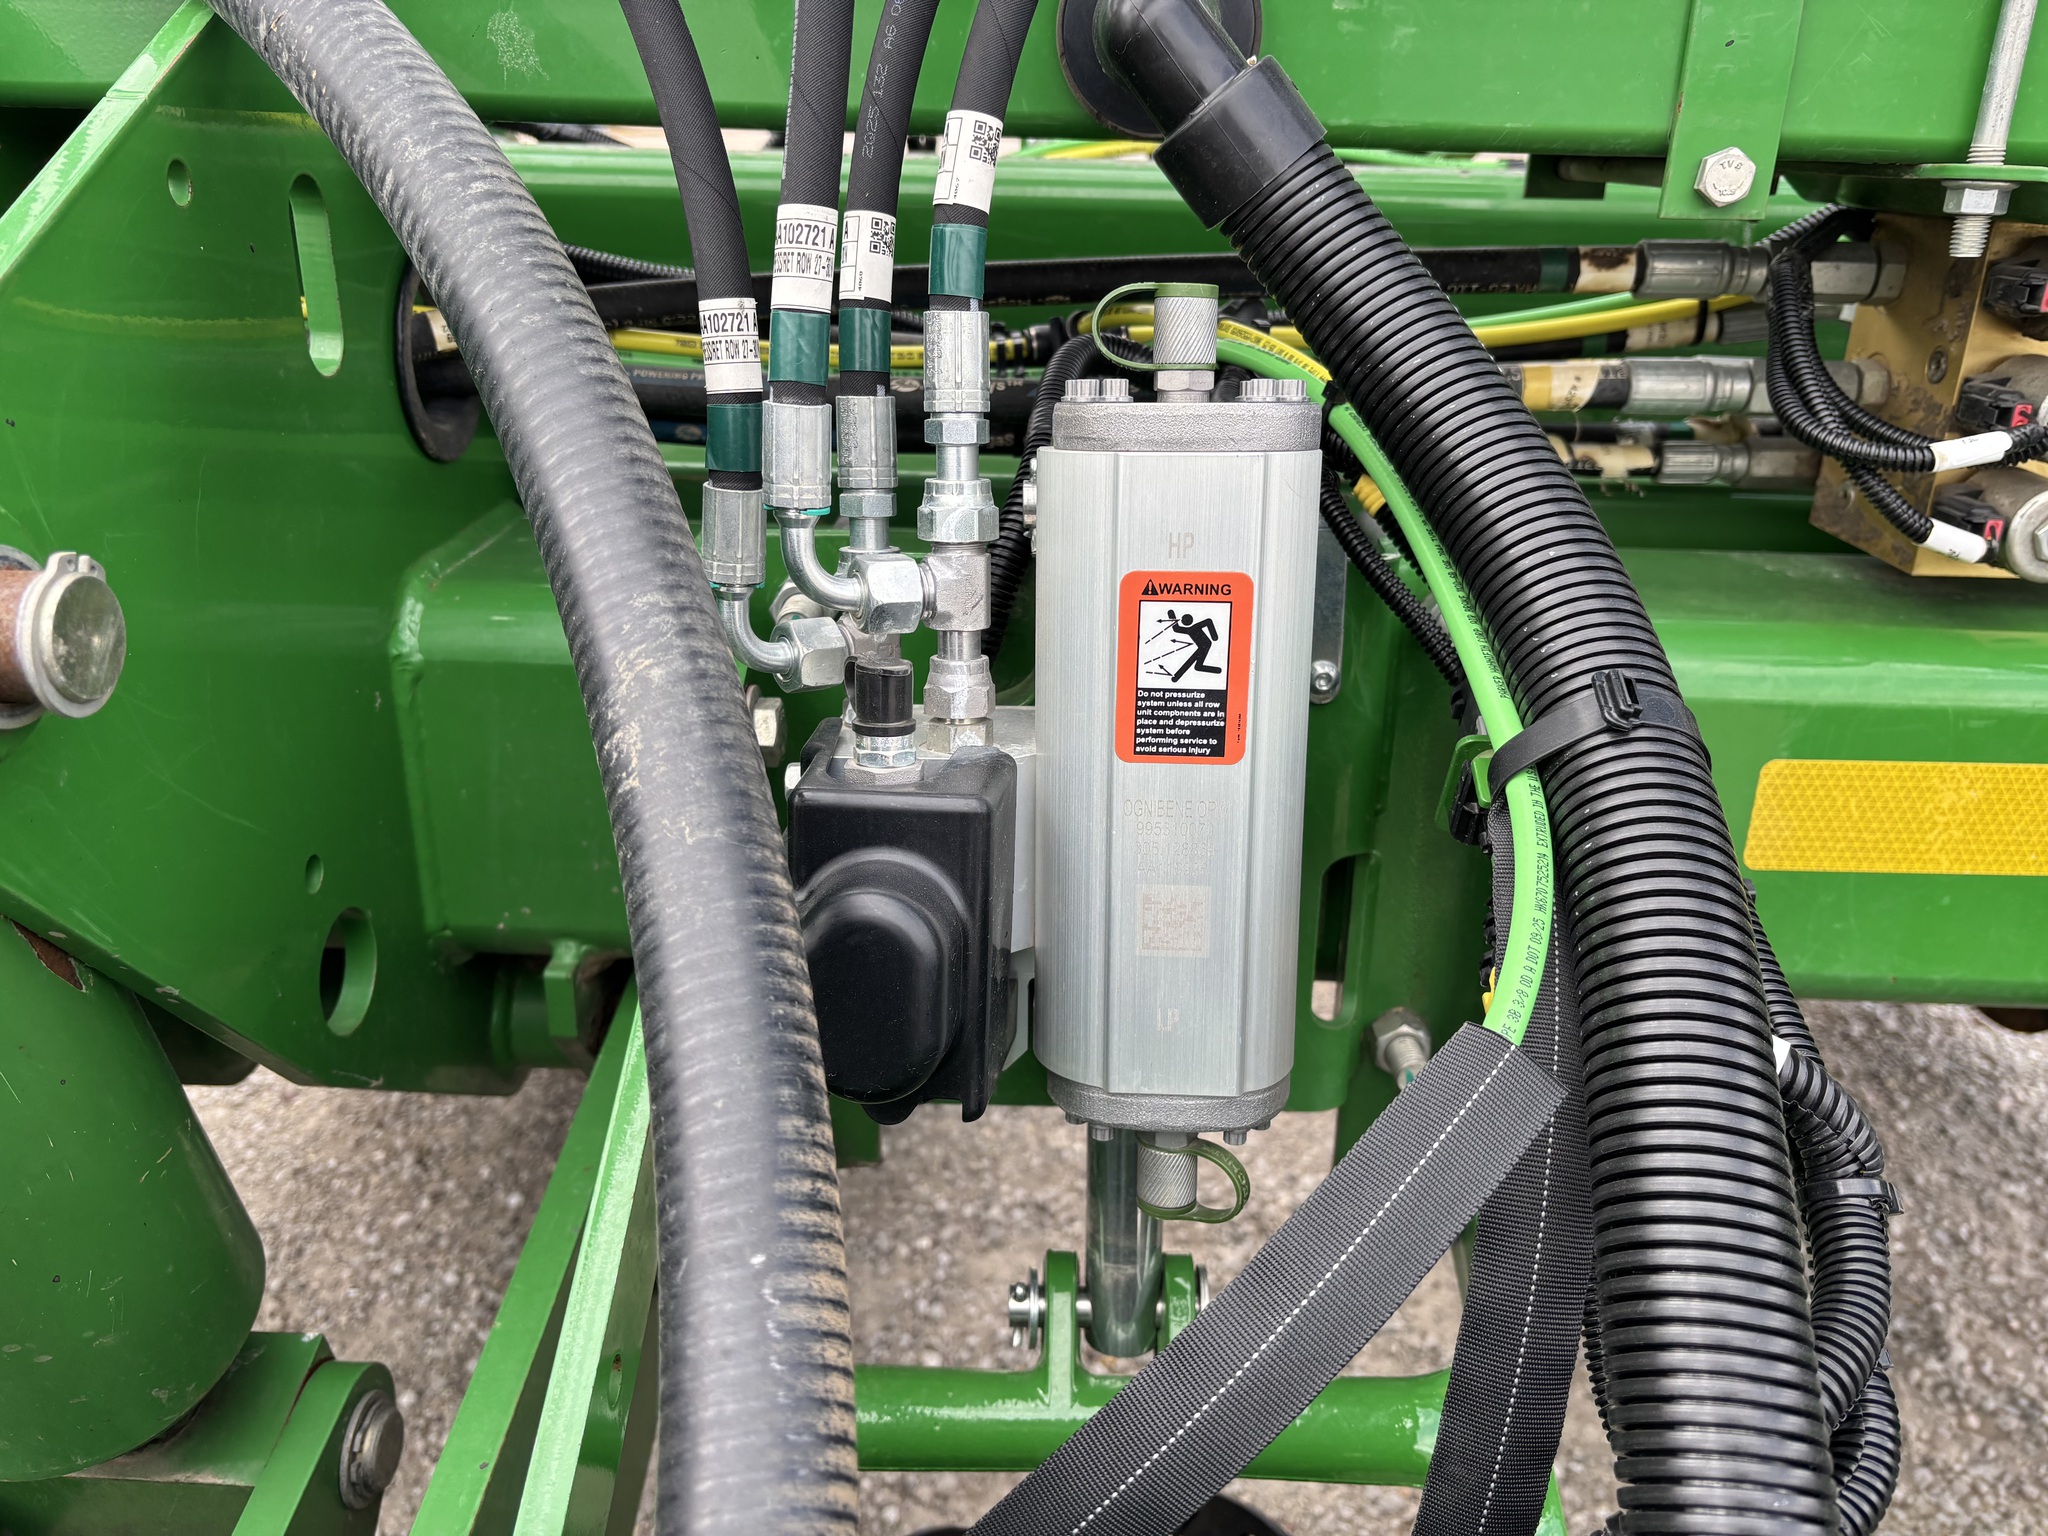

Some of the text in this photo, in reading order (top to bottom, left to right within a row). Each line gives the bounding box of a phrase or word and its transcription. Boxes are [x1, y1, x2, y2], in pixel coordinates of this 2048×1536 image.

[862, 105, 880, 159] 2025
[873, 63, 888, 98] 132
[829, 227, 835, 250] A
[796, 252, 812, 274] ROW
[725, 339, 740, 359] ROW
[1169, 531, 1194, 559] HP
[1158, 583, 1232, 596] WARNING
[1164, 691, 1206, 699] pressurize
[1136, 718, 1157, 726] place
[1175, 719, 1225, 727] depressurize
[1136, 736, 1178, 745] performing
[1188, 746, 1211, 755] injury
[1528, 783, 1542, 798] THE
[1123, 799, 1193, 818] OGNIBENE
[1531, 799, 1544, 810] IN
[1533, 810, 1549, 849] EXTRUDED
[1529, 917, 1546, 945] 09/25
[1525, 944, 1541, 965] DOT
[1523, 965, 1537, 975] A
[1512, 988, 1529, 1008] 3/8
[1506, 1008, 1522, 1023] 3B
